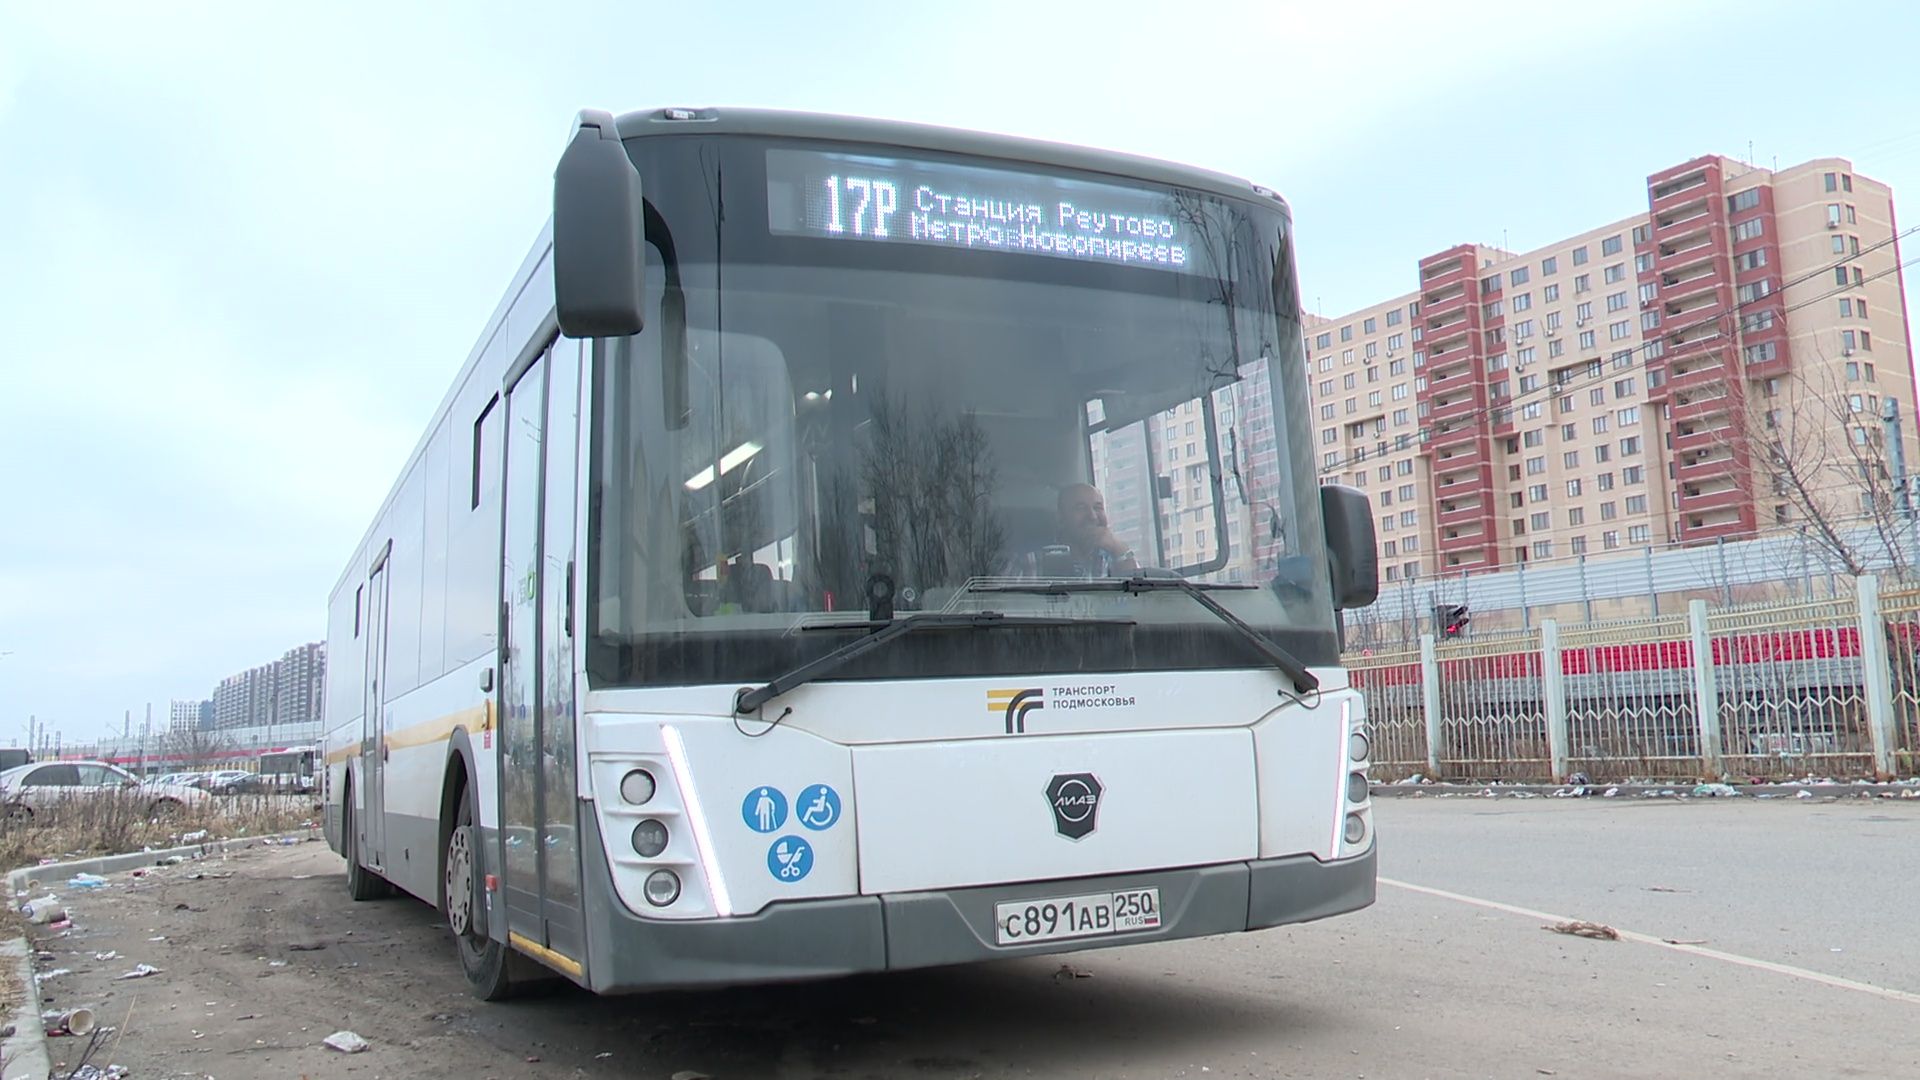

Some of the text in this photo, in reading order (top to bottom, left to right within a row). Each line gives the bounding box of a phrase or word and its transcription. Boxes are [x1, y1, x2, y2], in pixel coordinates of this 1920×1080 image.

[916, 185, 1174, 239] Станция Реутово
[911, 211, 1002, 247] Метро
[1052, 685, 1116, 697] ТРАНСПОРТ
[1053, 697, 1136, 710] ПОДМОСКОВЬЯ
[1054, 794, 1097, 808] ЛИАЗ
[1115, 892, 1154, 918] 250
[1125, 917, 1144, 927] RUS
